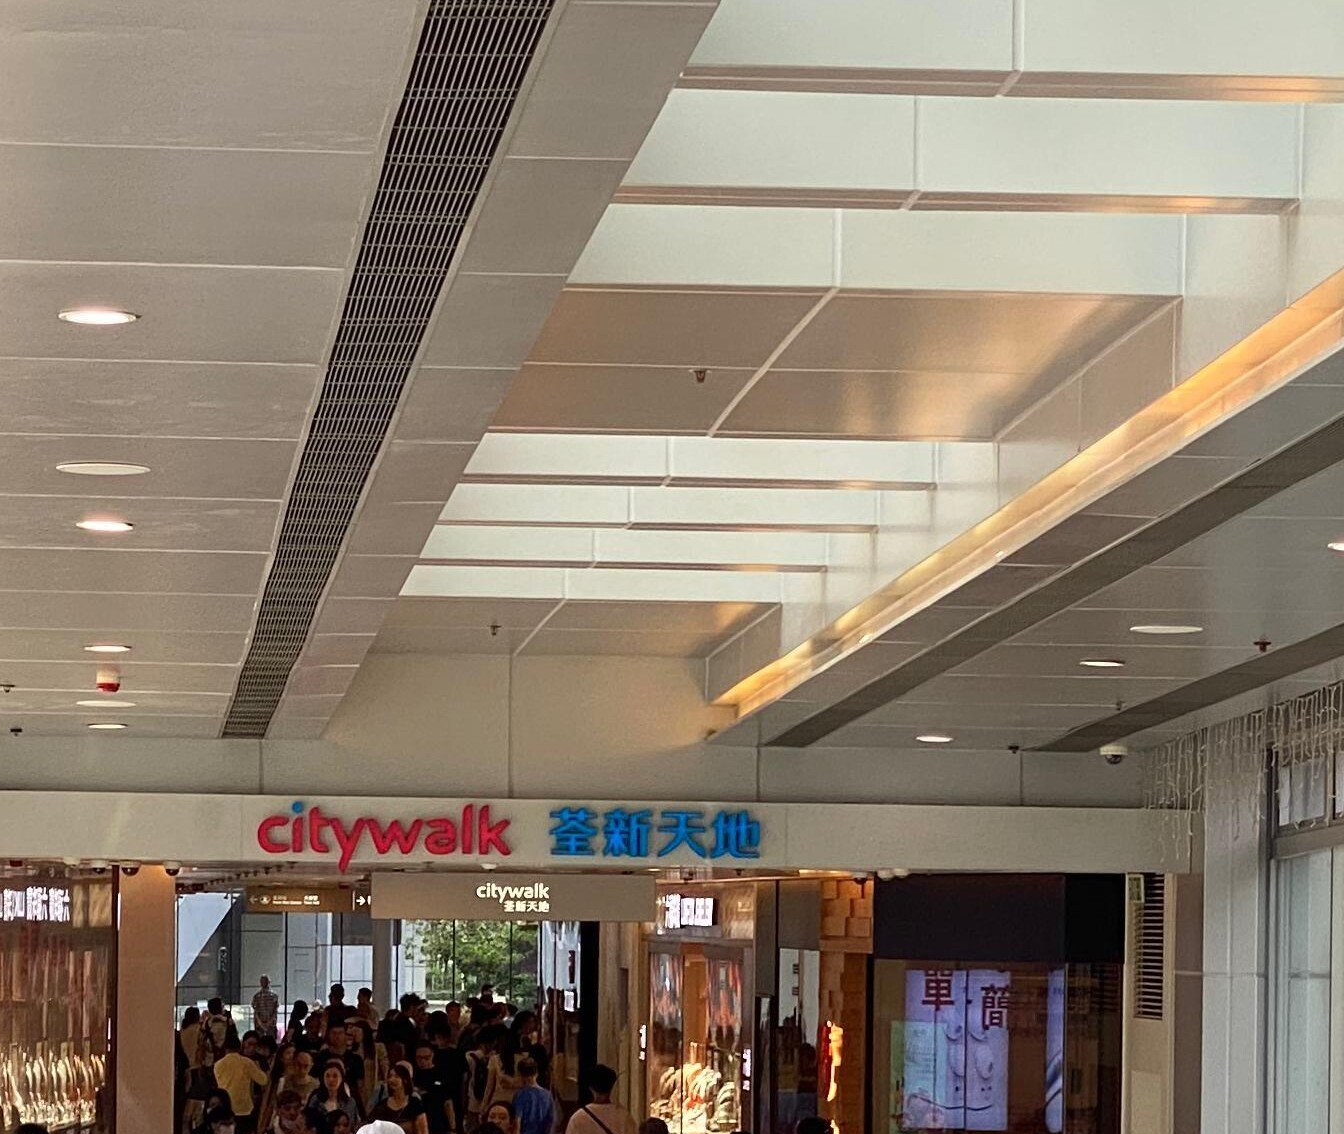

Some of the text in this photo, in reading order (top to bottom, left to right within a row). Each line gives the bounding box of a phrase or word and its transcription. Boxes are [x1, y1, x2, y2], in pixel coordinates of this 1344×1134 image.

[257, 800, 513, 872] citywalk
[549, 806, 761, 858] 荃新天地
[476, 882, 550, 903] citywalk
